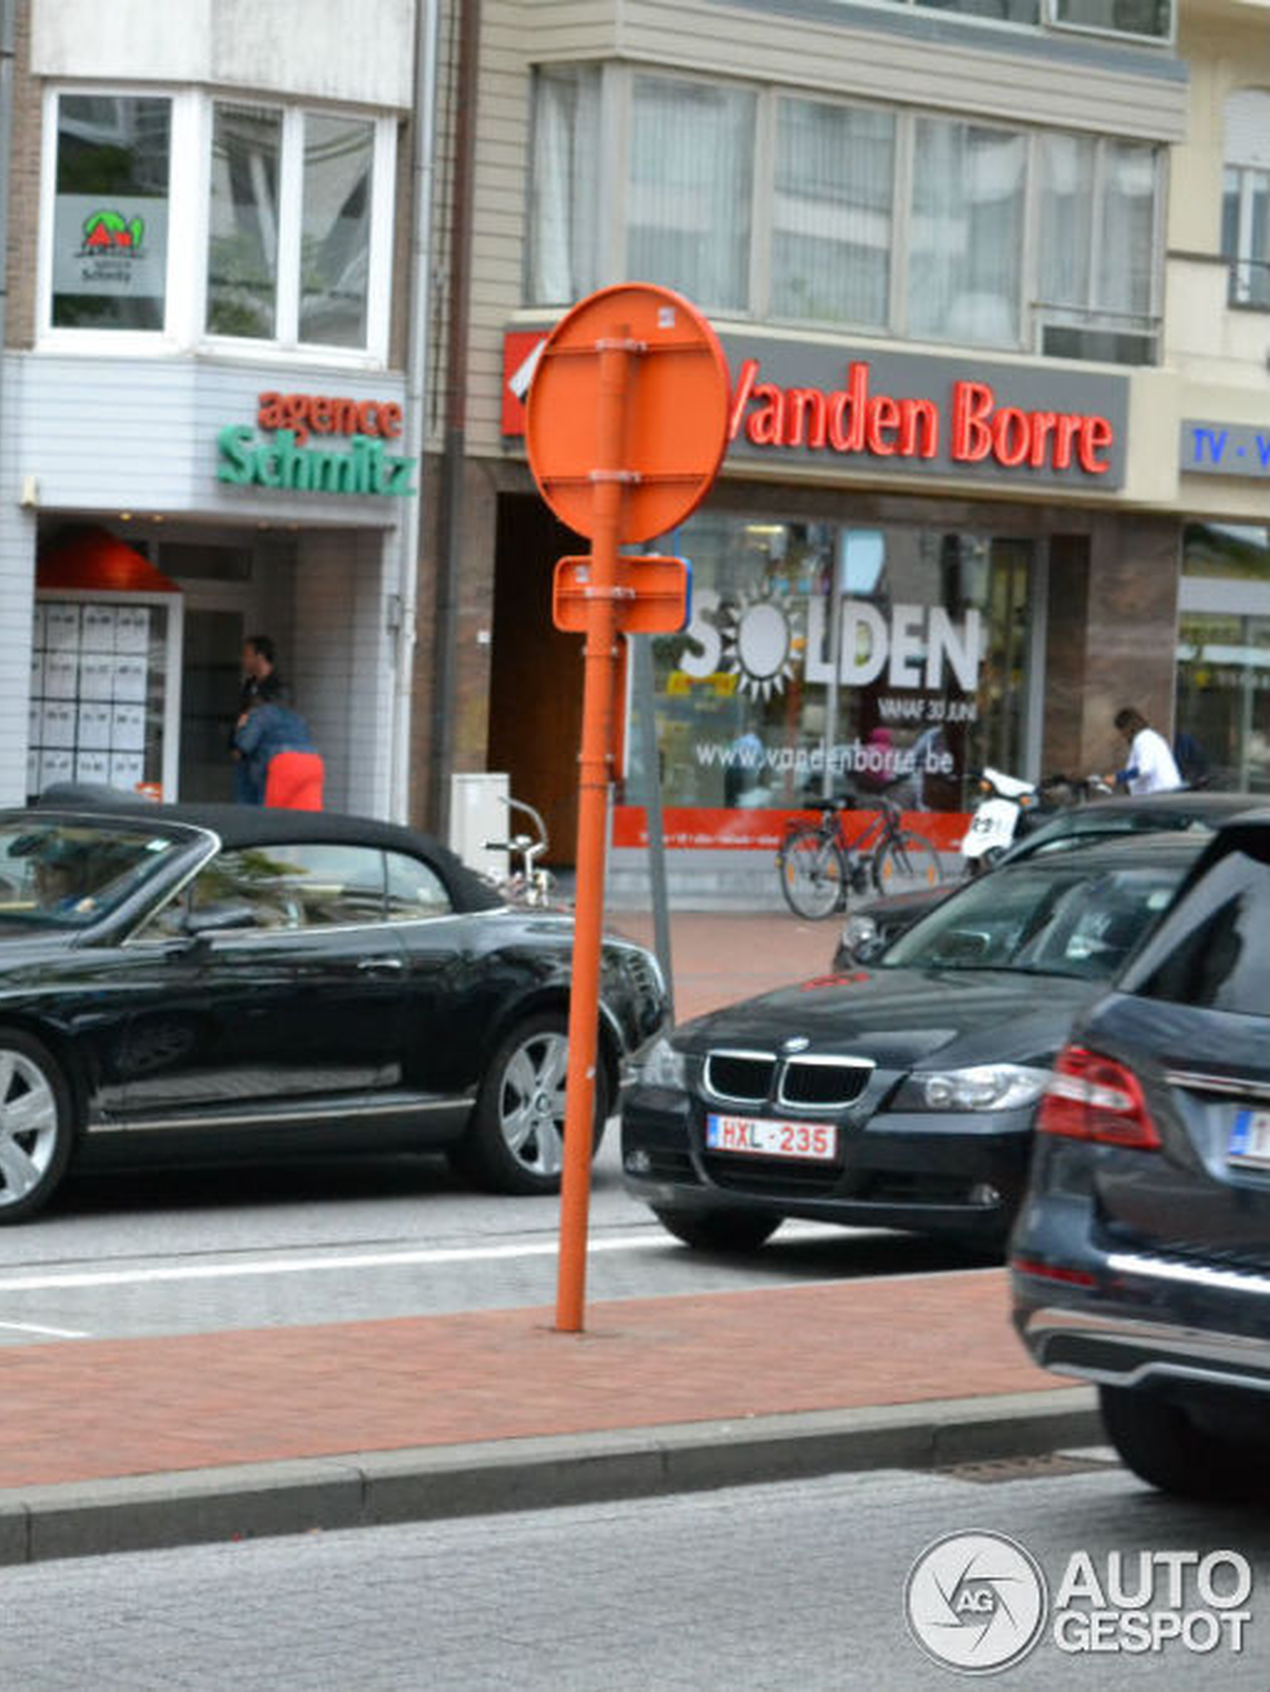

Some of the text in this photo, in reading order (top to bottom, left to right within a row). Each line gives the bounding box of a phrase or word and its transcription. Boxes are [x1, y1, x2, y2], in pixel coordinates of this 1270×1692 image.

[258, 391, 403, 447] agence
[952, 380, 1112, 474] Borre
[1191, 428, 1229, 463] TV
[218, 425, 417, 497] Schmitz
[678, 588, 982, 692] SOLDEN
[877, 696, 926, 719] VANAF
[723, 1120, 827, 1154] HXL-235
